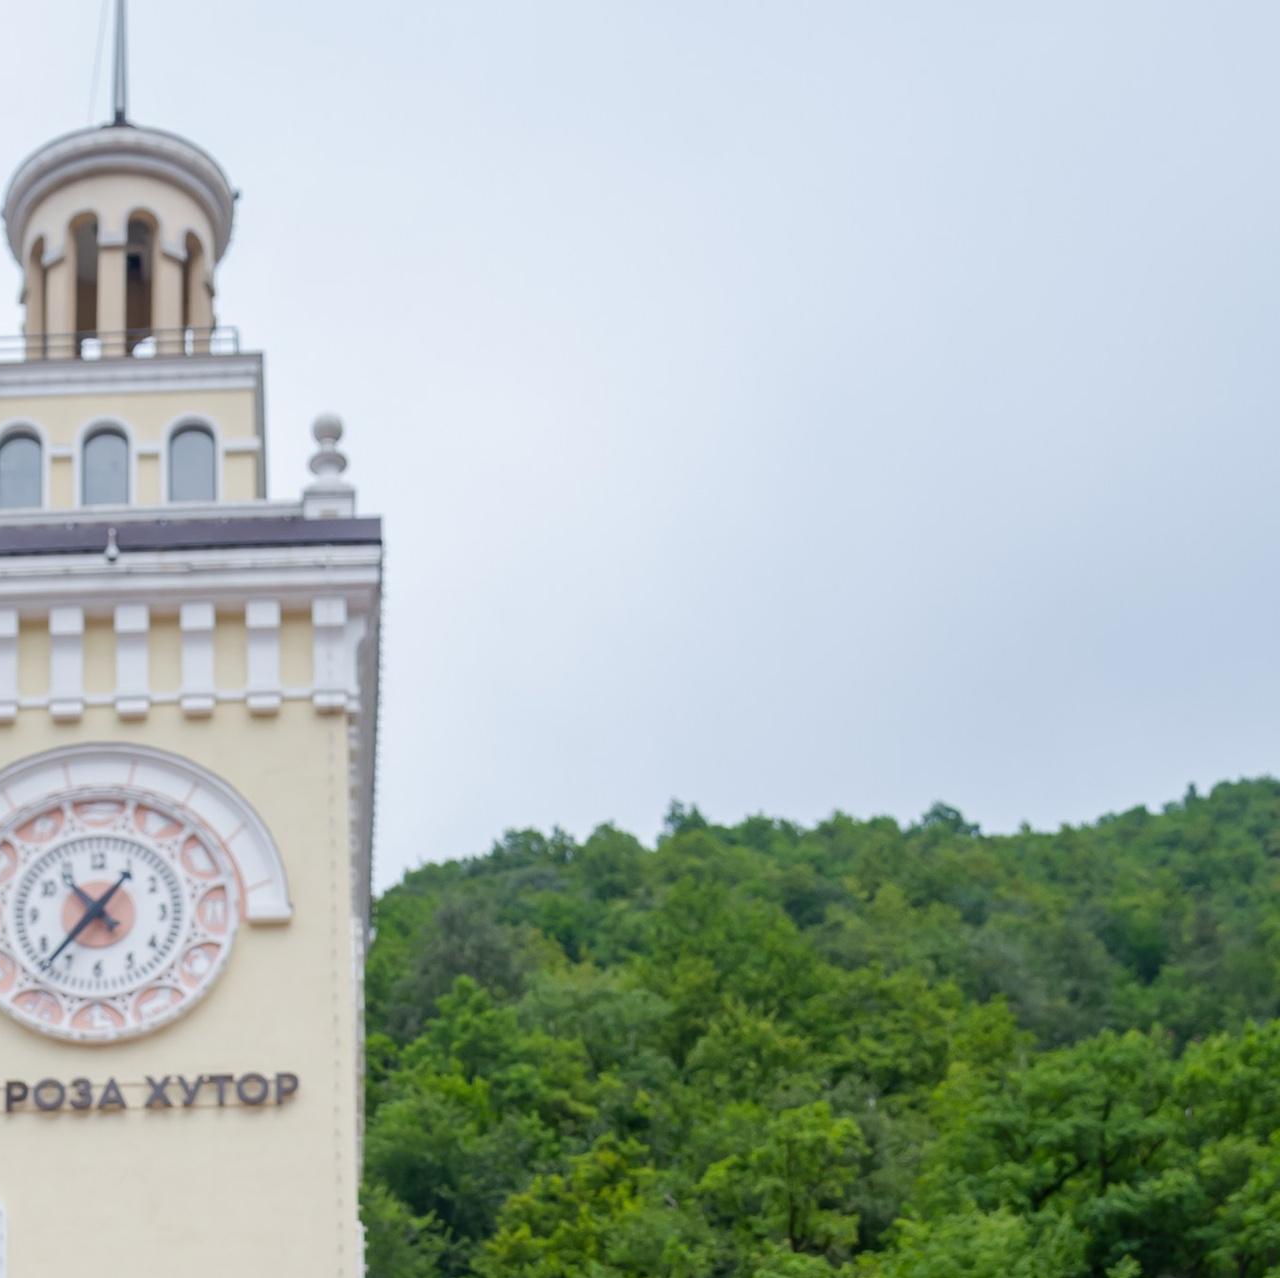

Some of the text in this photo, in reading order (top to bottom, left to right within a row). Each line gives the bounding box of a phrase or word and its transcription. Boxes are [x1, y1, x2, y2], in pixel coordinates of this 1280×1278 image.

[42, 880, 56, 897] 10
[93, 960, 103, 978] 6
[5, 1072, 300, 1112] РОЗА ХУТОР
